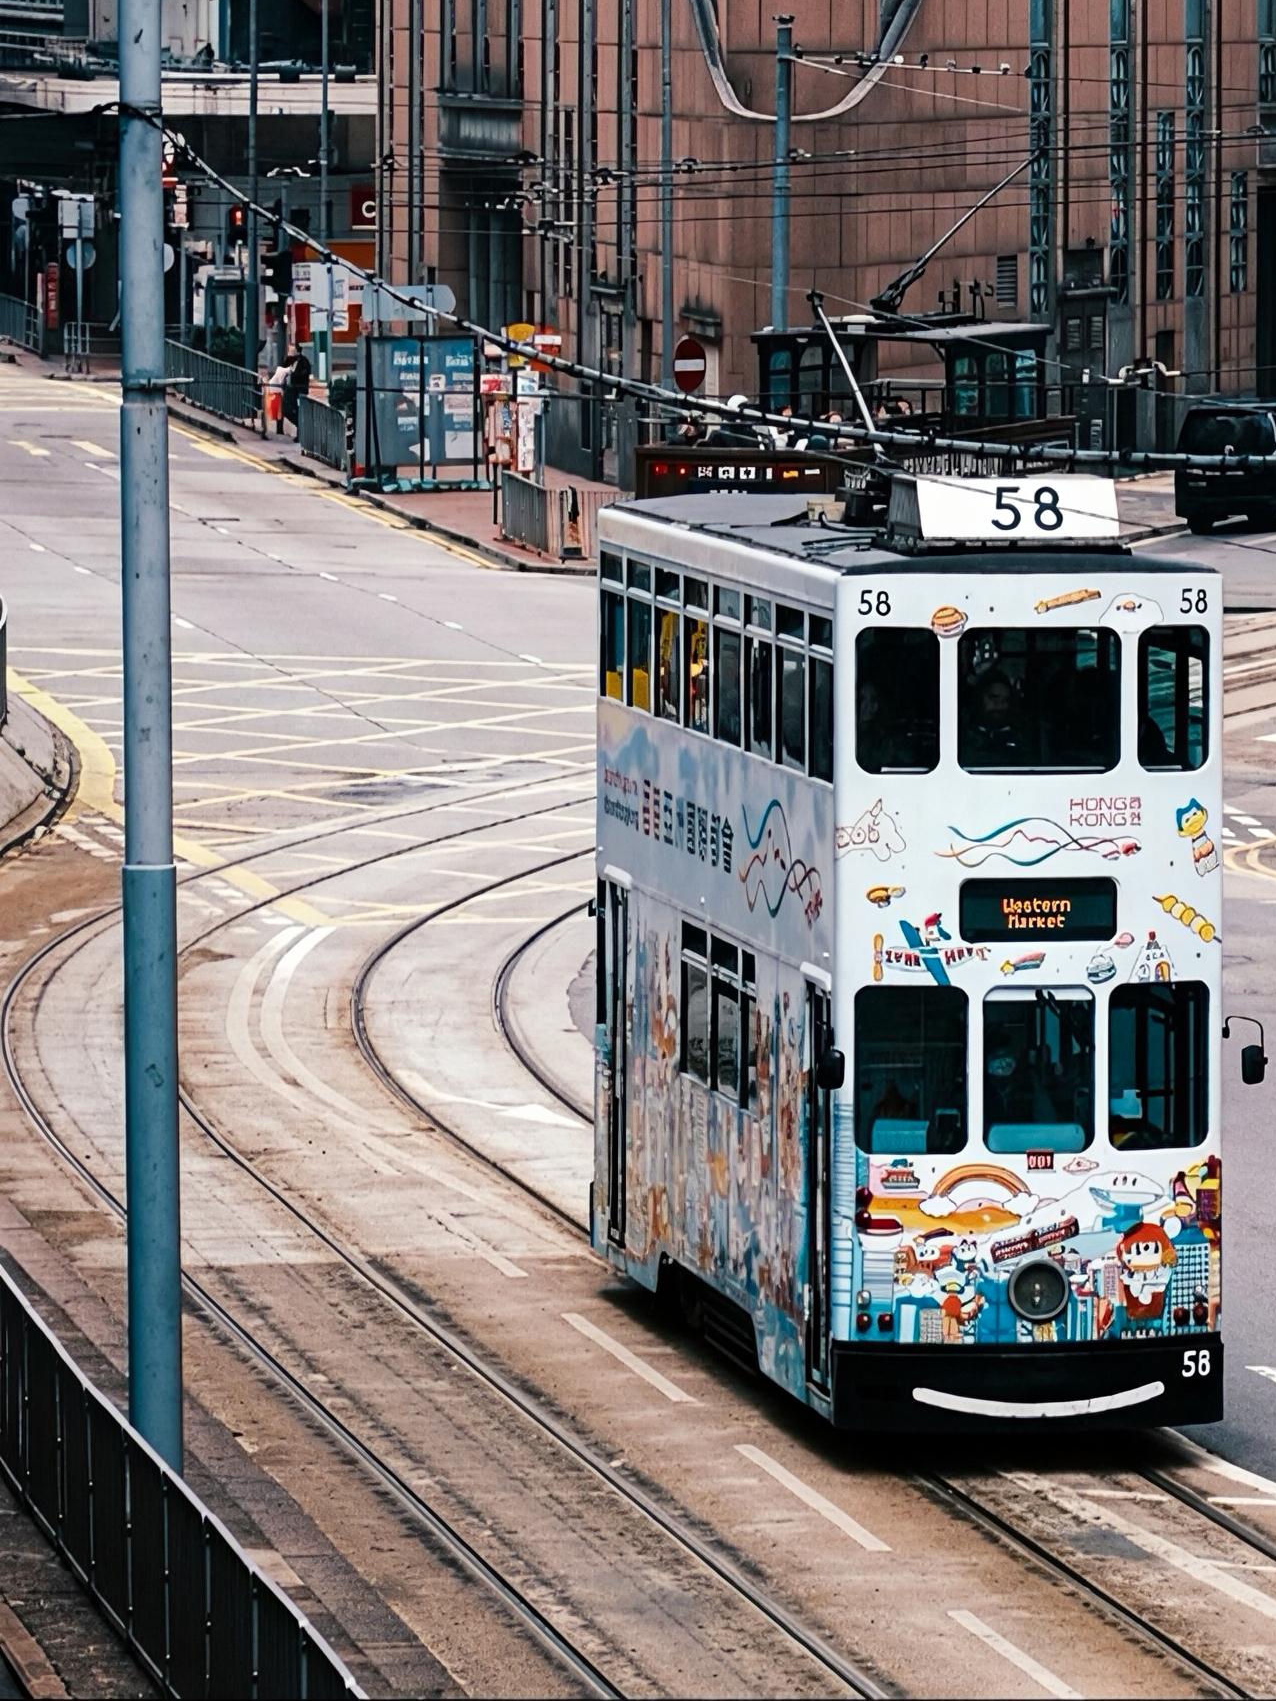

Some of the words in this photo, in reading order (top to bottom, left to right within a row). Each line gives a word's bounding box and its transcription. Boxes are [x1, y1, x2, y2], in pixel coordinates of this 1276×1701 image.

[991, 487, 1063, 530] 58
[859, 590, 891, 615] 58
[1180, 589, 1207, 614] 58
[1070, 797, 1127, 811] HONG
[1070, 812, 1127, 827] KONG
[1008, 914, 1066, 928] Market
[1181, 1350, 1210, 1377] 58
